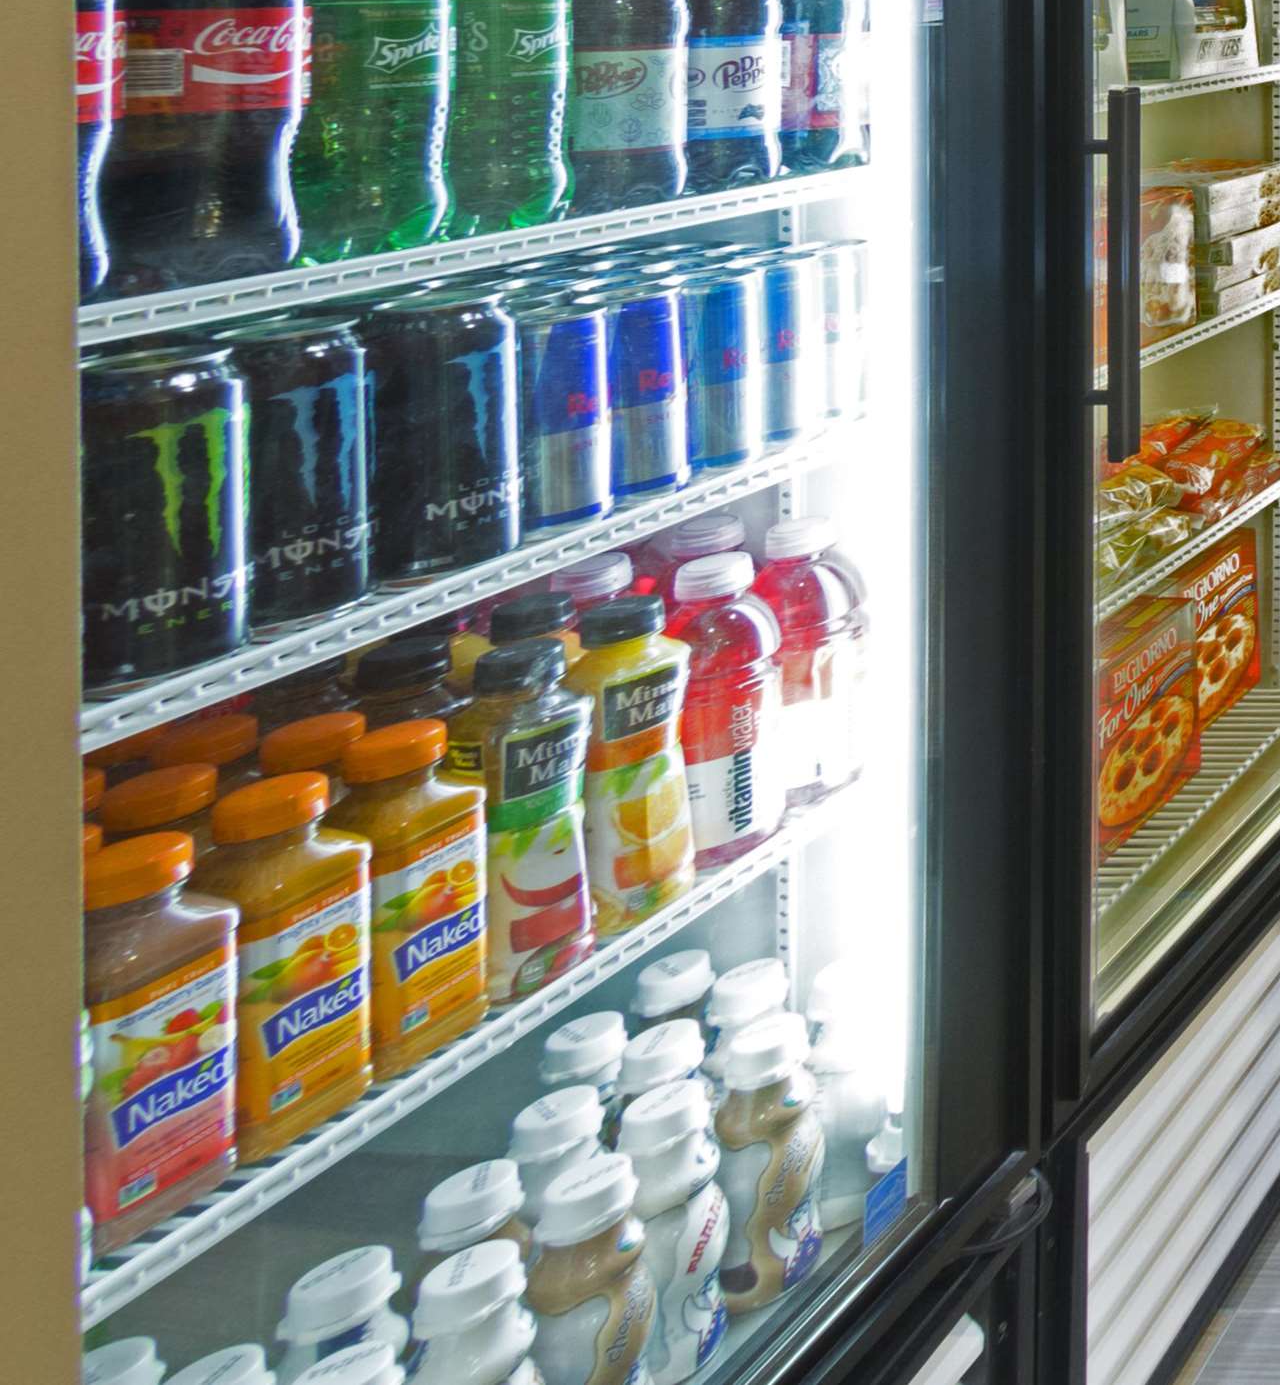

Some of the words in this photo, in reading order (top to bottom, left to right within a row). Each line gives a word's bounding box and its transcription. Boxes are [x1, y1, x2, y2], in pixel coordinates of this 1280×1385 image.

[741, 55, 762, 76] Dr
[1184, 552, 1240, 600] DIGIORNO
[1114, 627, 1178, 690] DIGIORNO
[1099, 708, 1126, 749] For
[1124, 677, 1153, 720] One
[728, 698, 754, 833] vitaminwater
[406, 915, 485, 970] Naked
[276, 981, 365, 1045] Naked
[127, 1059, 236, 1134] Naked
